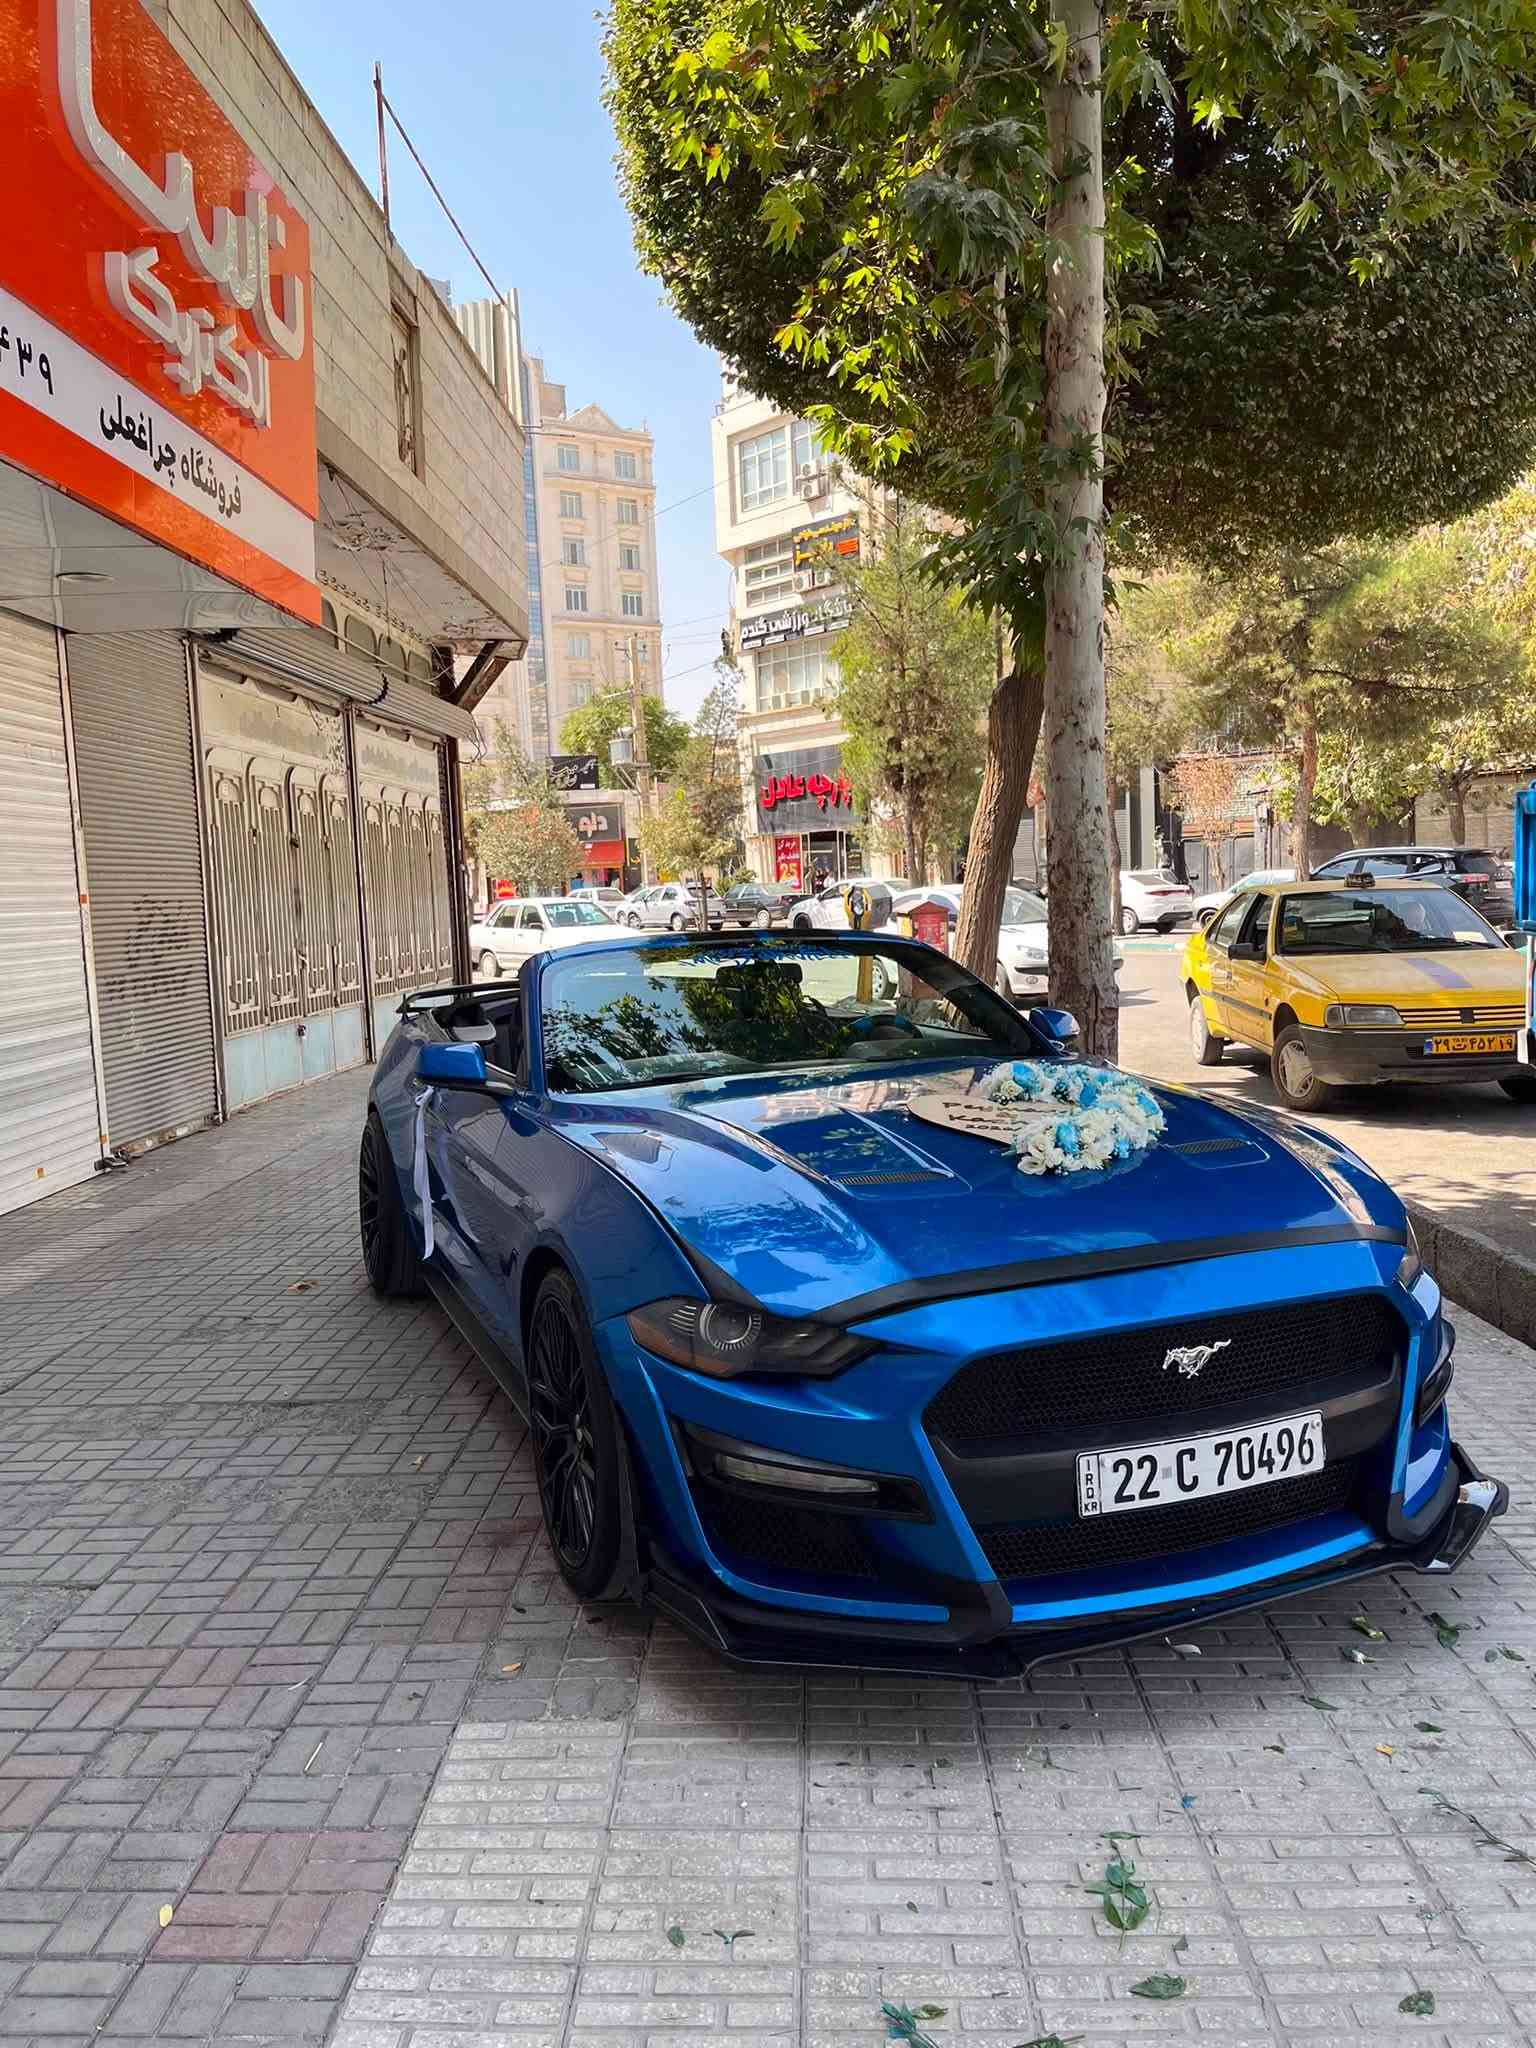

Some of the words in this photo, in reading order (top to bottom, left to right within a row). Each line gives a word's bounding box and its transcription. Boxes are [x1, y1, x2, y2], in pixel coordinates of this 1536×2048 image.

[100, 395, 176, 488] چراغعلی
[181, 448, 241, 518] فروشگاه
[769, 610, 809, 632] ورزشی
[759, 771, 805, 809] عادل
[807, 770, 854, 809] پارچه
[779, 863, 797, 881] 25
[1113, 1455, 1160, 1504] 22
[1176, 1448, 1199, 1492] C
[1214, 1423, 1315, 1486] 70496
[1084, 1502, 1098, 1513] KR
